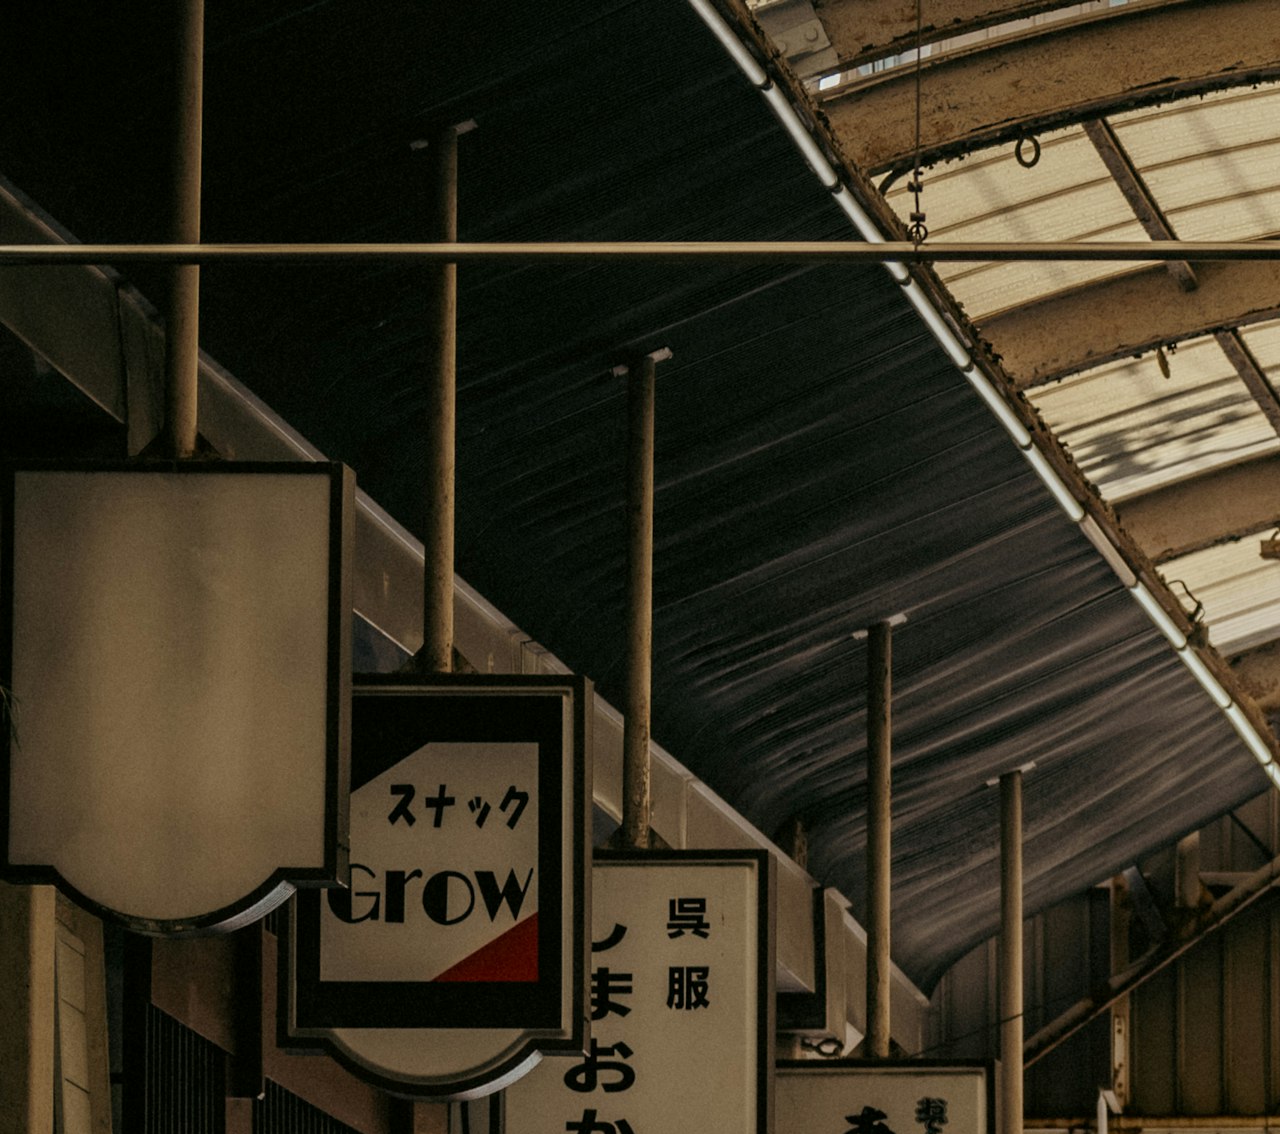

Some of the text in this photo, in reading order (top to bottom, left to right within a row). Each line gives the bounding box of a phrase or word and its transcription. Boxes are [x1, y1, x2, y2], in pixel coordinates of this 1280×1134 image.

[387, 783, 530, 830] スナック
[666, 896, 711, 1010] 呉服
